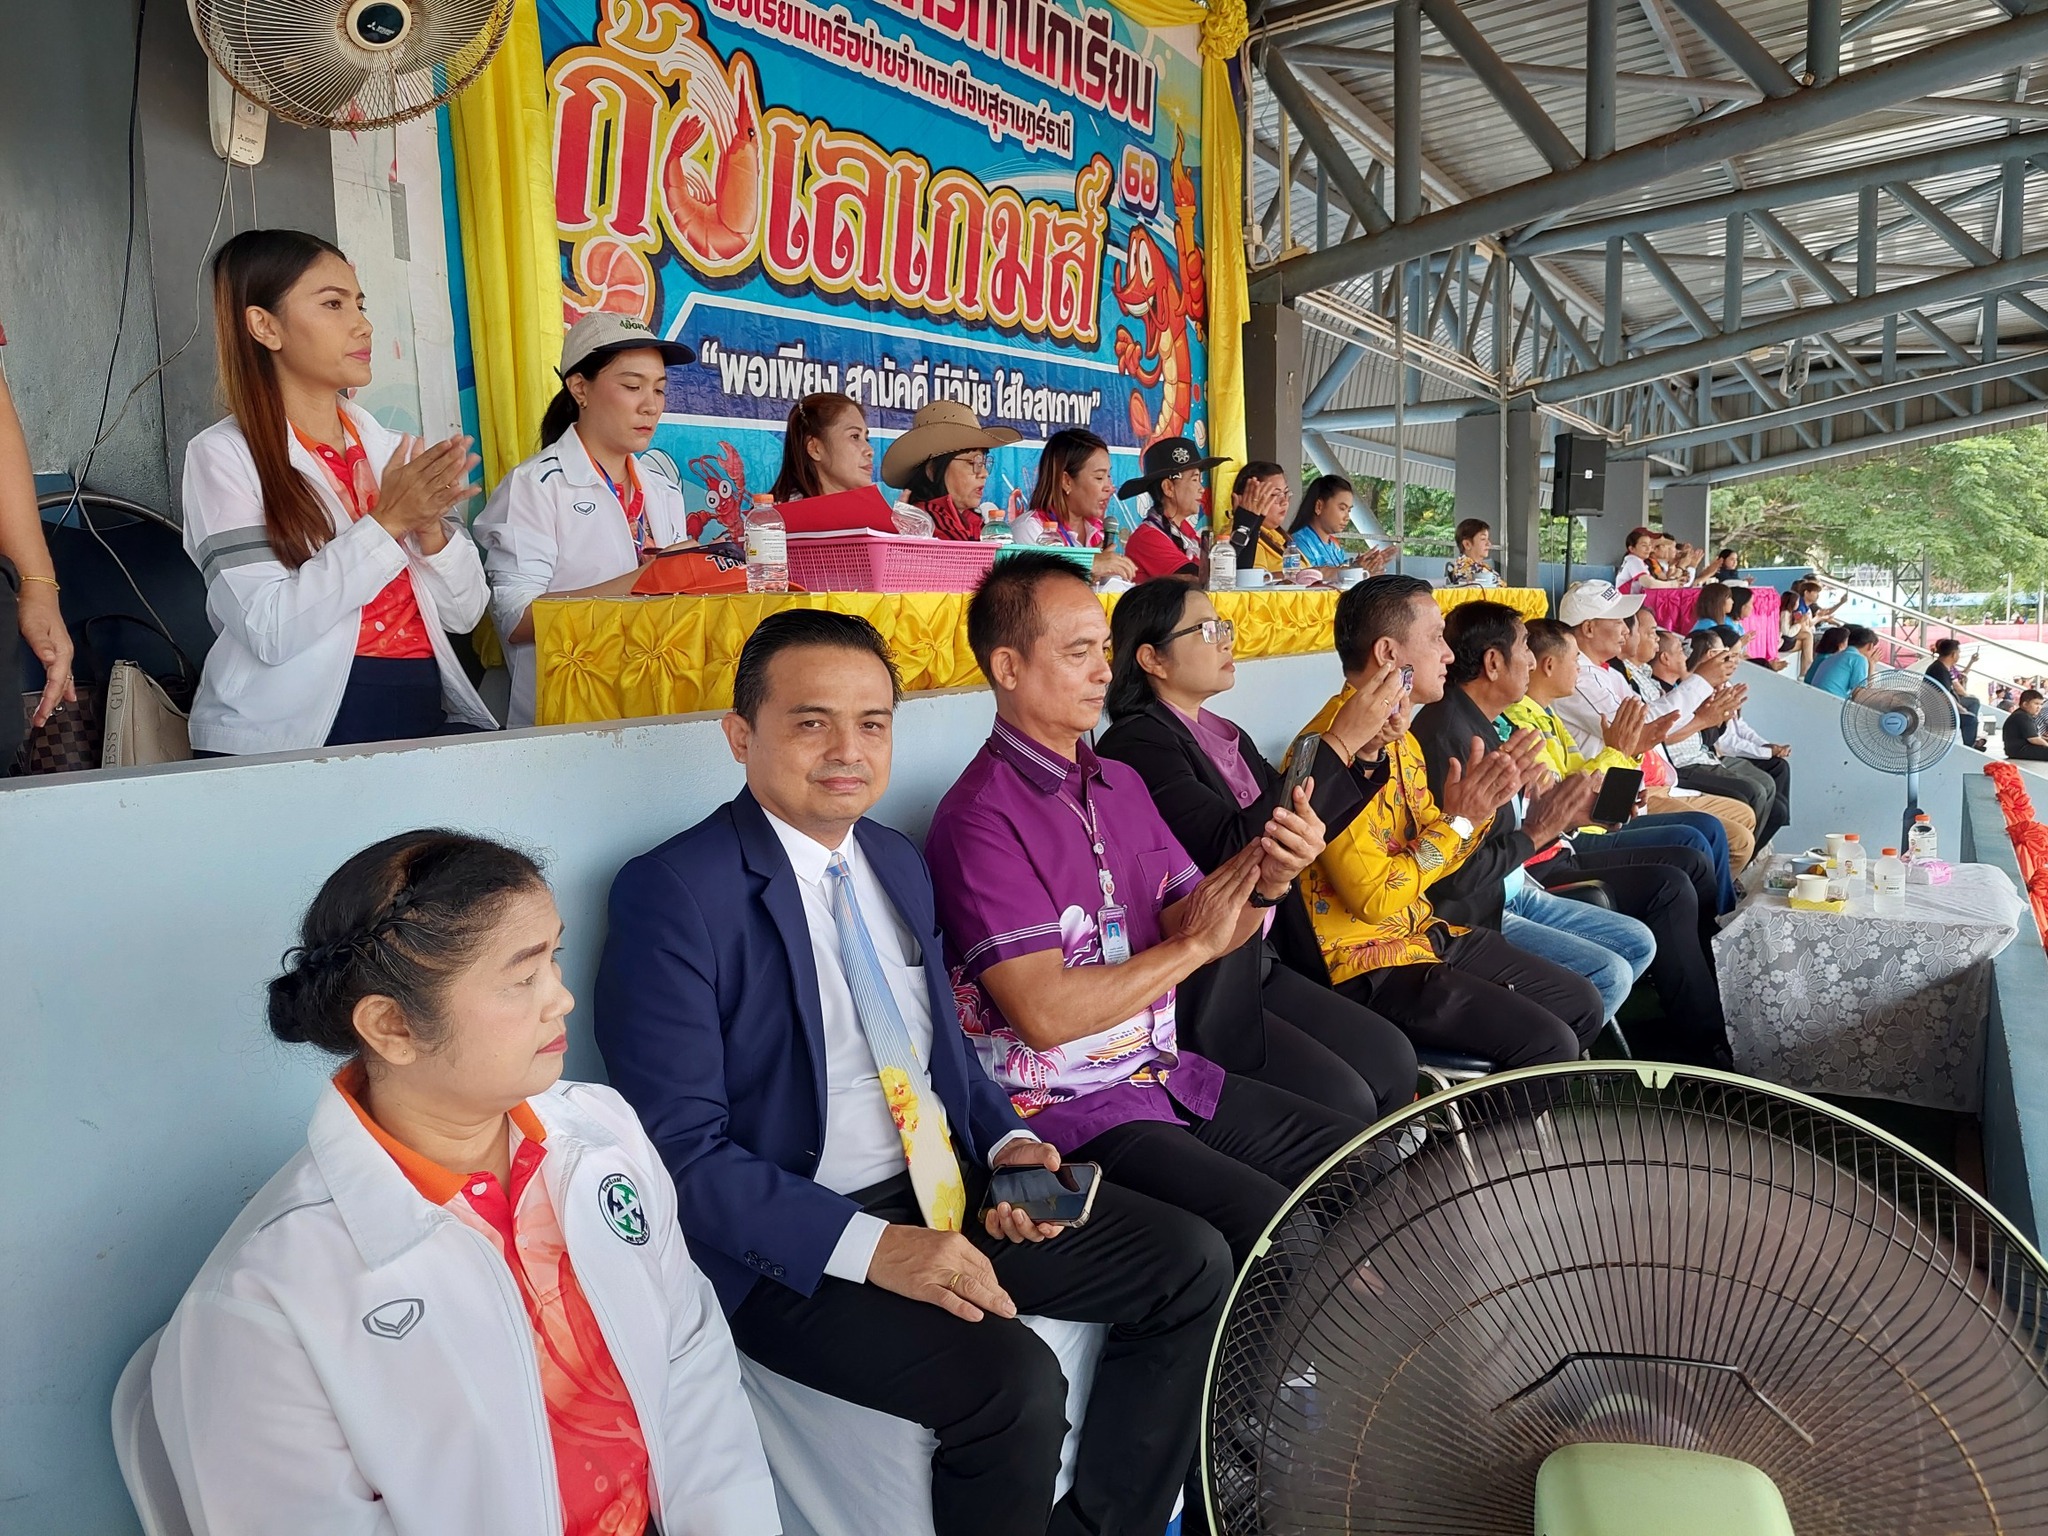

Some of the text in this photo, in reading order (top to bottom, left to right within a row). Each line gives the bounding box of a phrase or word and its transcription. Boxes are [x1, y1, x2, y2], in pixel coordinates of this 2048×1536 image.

[1124, 149, 1157, 206] 68
[845, 357, 929, 410] สามัคคี
[934, 363, 992, 417] มีวินัย
